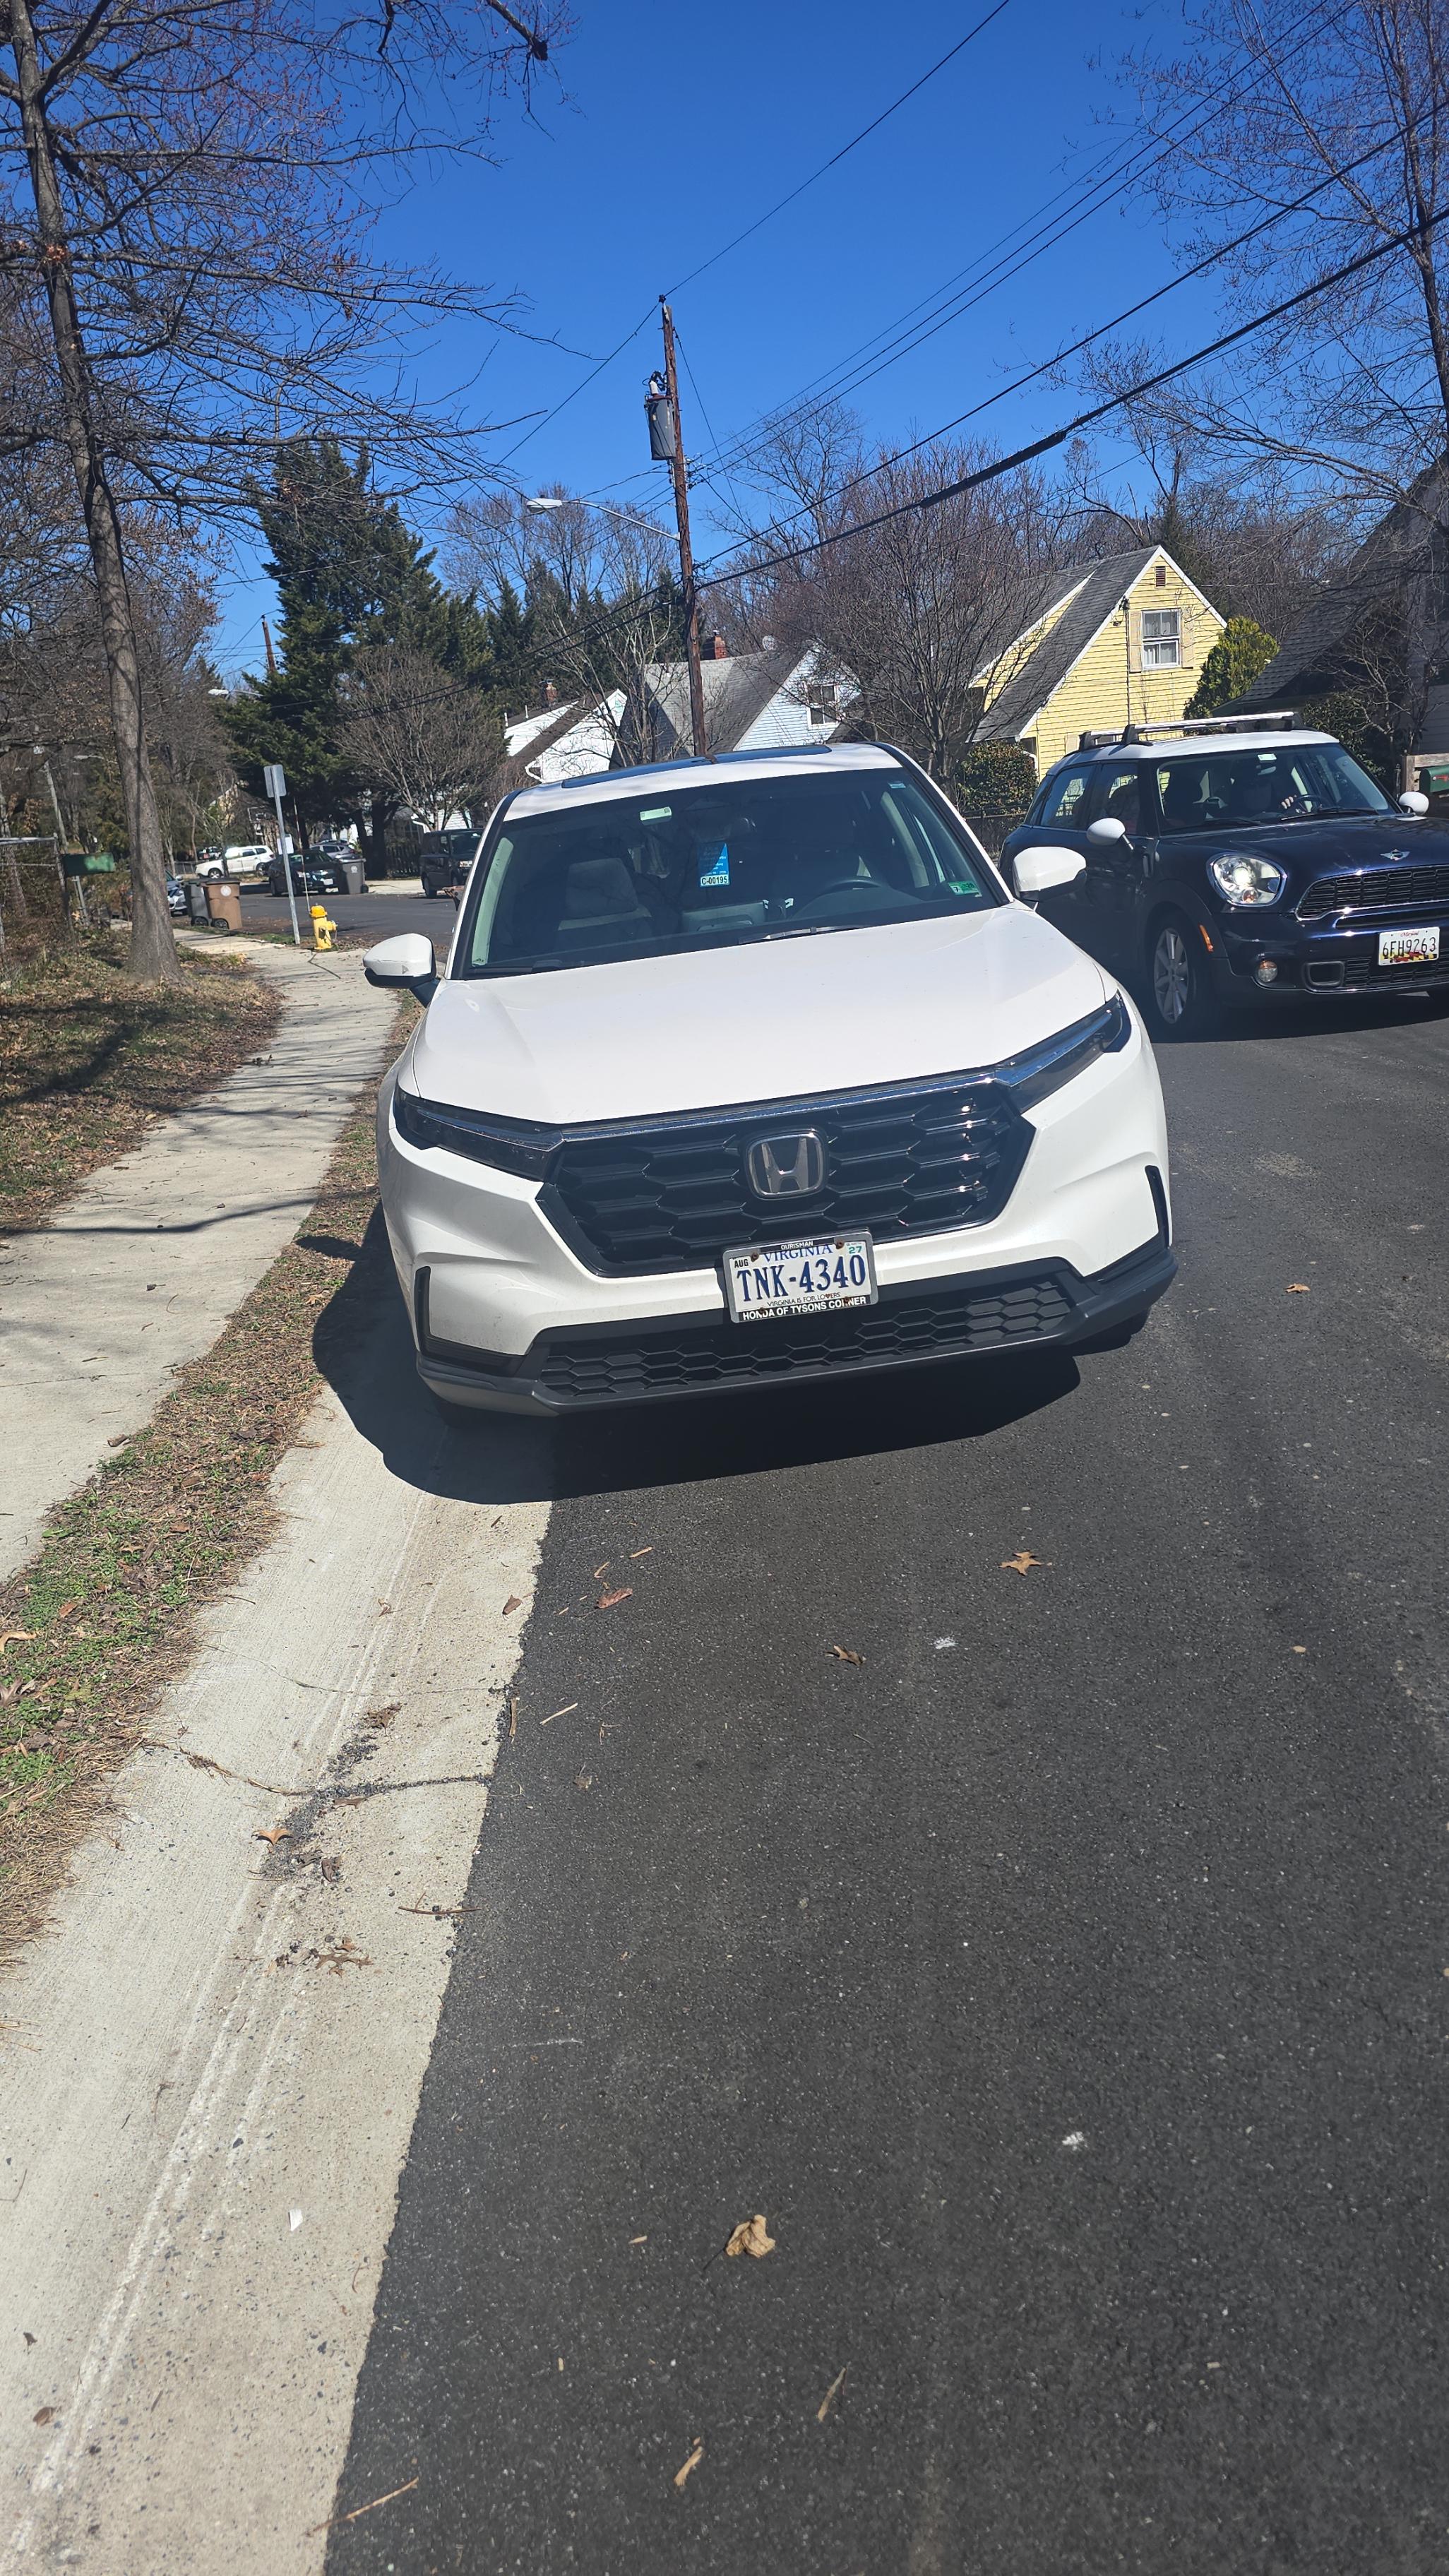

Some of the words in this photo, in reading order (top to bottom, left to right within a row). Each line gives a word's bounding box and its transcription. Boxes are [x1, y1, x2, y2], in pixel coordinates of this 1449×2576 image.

[702, 876, 727, 885] C-00195
[1383, 937, 1436, 957] 6FH9263
[780, 1241, 813, 1250] OURISMAN
[849, 1246, 861, 1254] 27
[764, 1244, 833, 1262] VIRGINIA
[734, 1259, 749, 1268] AUG
[737, 1254, 866, 1301] TNK-4340
[777, 1306, 789, 1316] OF
[790, 1301, 827, 1313] TYSONS
